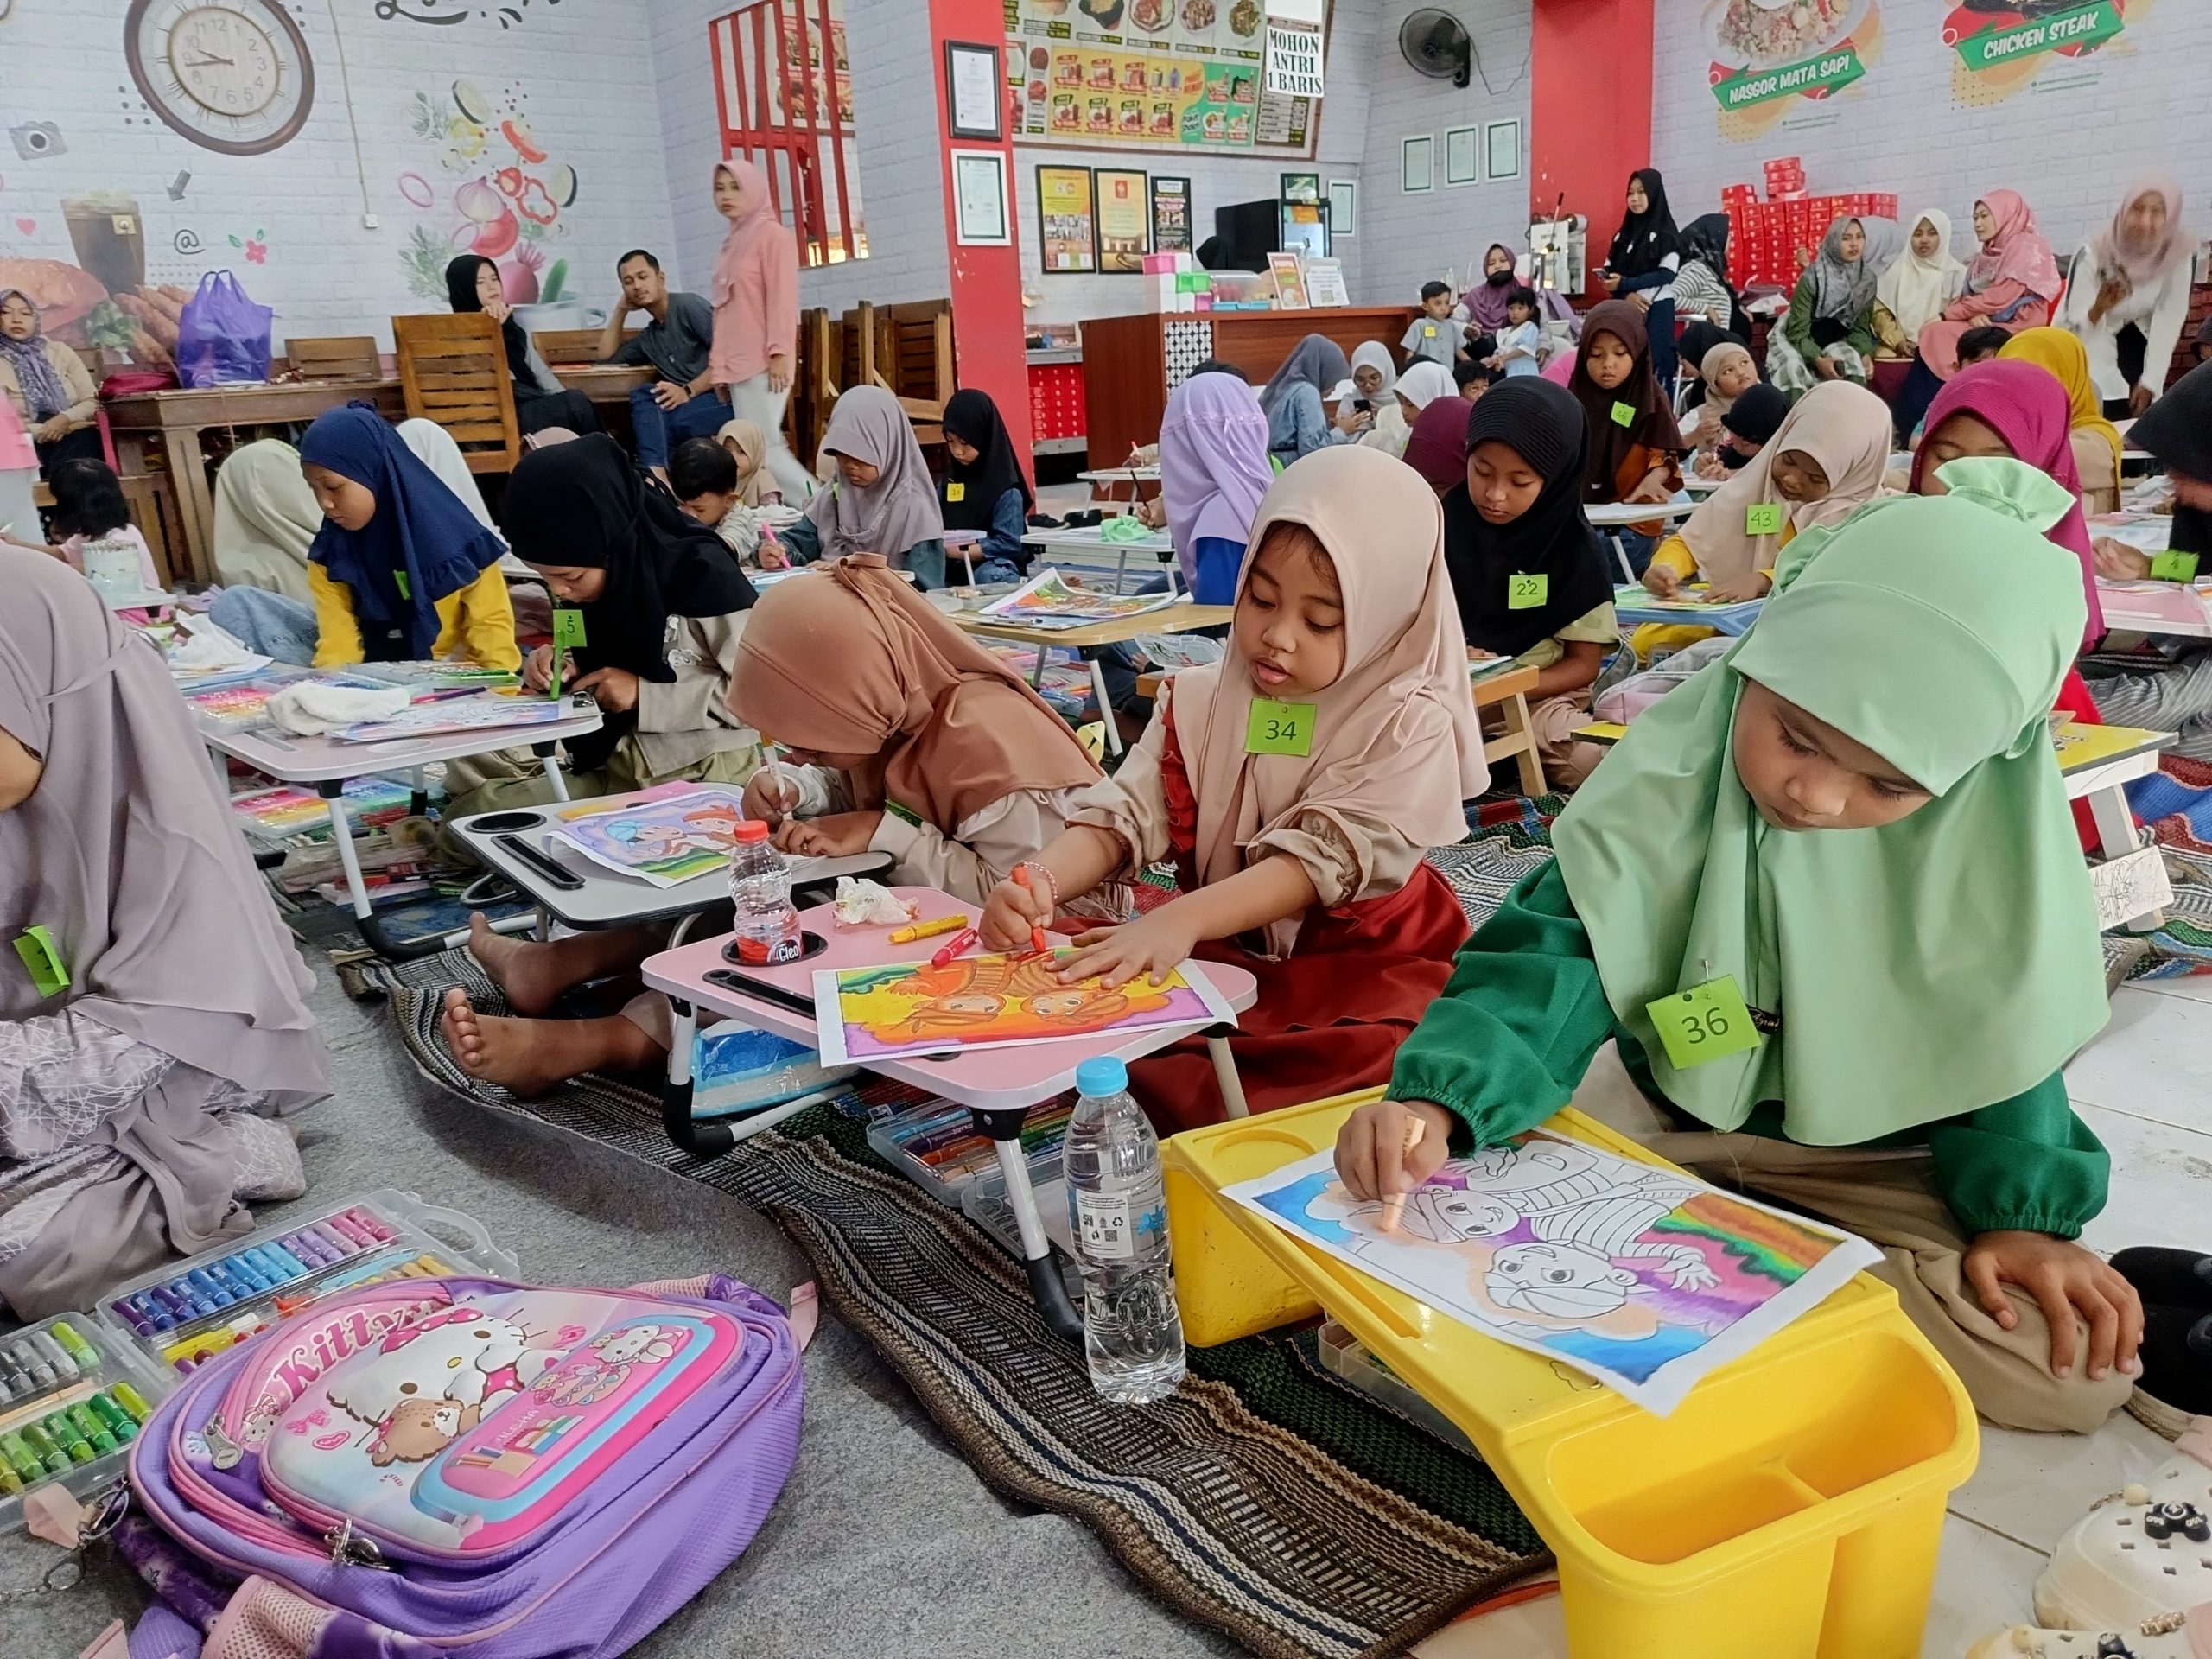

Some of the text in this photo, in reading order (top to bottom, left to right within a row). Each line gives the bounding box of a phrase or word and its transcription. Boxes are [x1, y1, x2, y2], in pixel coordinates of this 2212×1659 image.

[194, 22, 207, 35] 11
[210, 17, 227, 32] 12
[185, 35, 200, 49] 10
[1269, 29, 1319, 54] MOHON
[1983, 10, 2099, 60] CHICKEN STEAK
[246, 38, 259, 52] 2
[257, 56, 267, 71] 3
[1272, 51, 1315, 74] ANTRI
[191, 70, 202, 85] 8
[254, 75, 264, 88] 4
[1268, 71, 1322, 95] 1 BARIS
[1729, 54, 1850, 105] NASGOR MATA SAPI
[208, 85, 219, 100] 7
[226, 89, 238, 104] 6
[243, 86, 254, 102] 5
[1751, 511, 1773, 527] 43
[1516, 582, 1539, 596] 22
[567, 620, 575, 634] 5
[1264, 719, 1297, 741] 34
[1681, 1007, 1729, 1045] 36
[272, 1306, 408, 1404] Kitty
